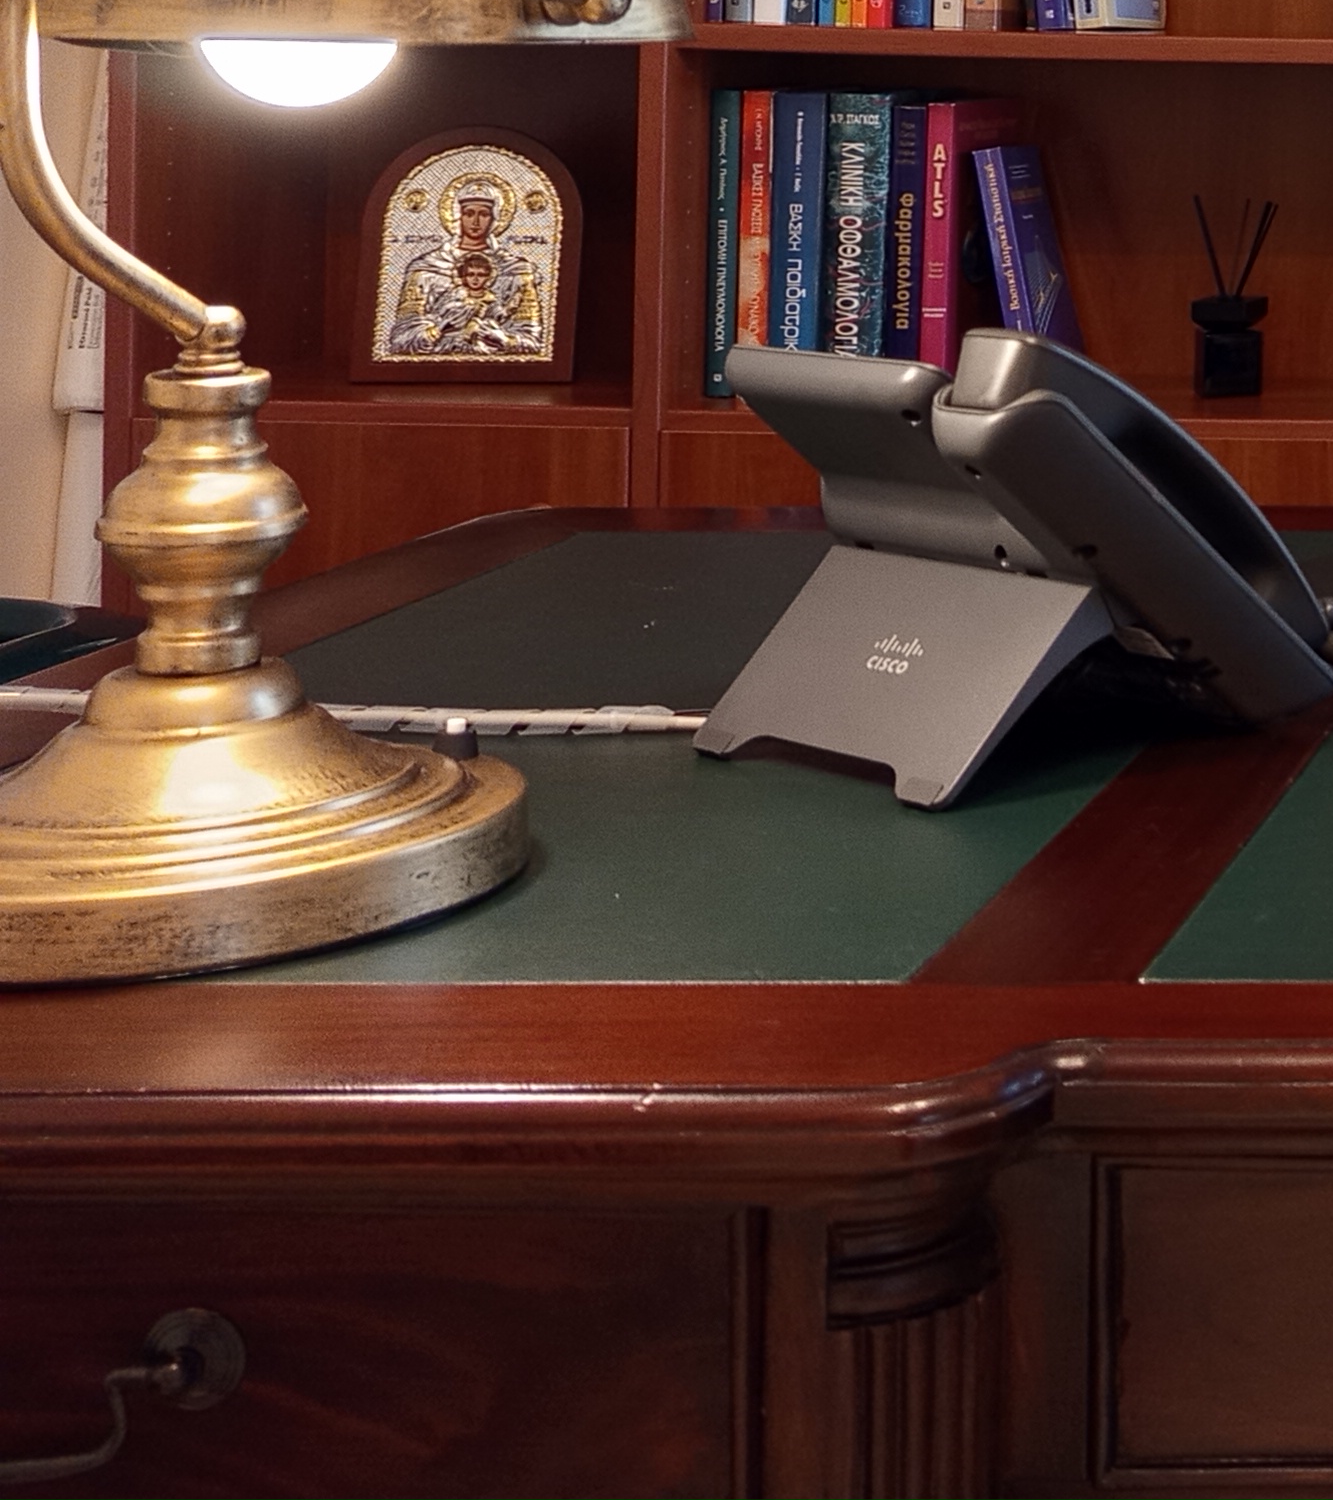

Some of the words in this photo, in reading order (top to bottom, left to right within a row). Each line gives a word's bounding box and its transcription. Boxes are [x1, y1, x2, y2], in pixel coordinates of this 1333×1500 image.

[839, 141, 866, 207] ΚΛΙΝΙΚΗ
[932, 143, 948, 218] ATLS
[716, 219, 728, 266] ΕΠΙΤΟΜΗ
[1000, 224, 1015, 268] Ιατρική
[714, 266, 727, 352] ΠΝΕΥΜΟΝΟΛΟΓΙΑ
[779, 257, 807, 351] Παιδιατρικ
[833, 214, 863, 359] ΟΦΘΑΛΜΟΛΟΓΙΑ
[1005, 269, 1021, 311] Βασική
